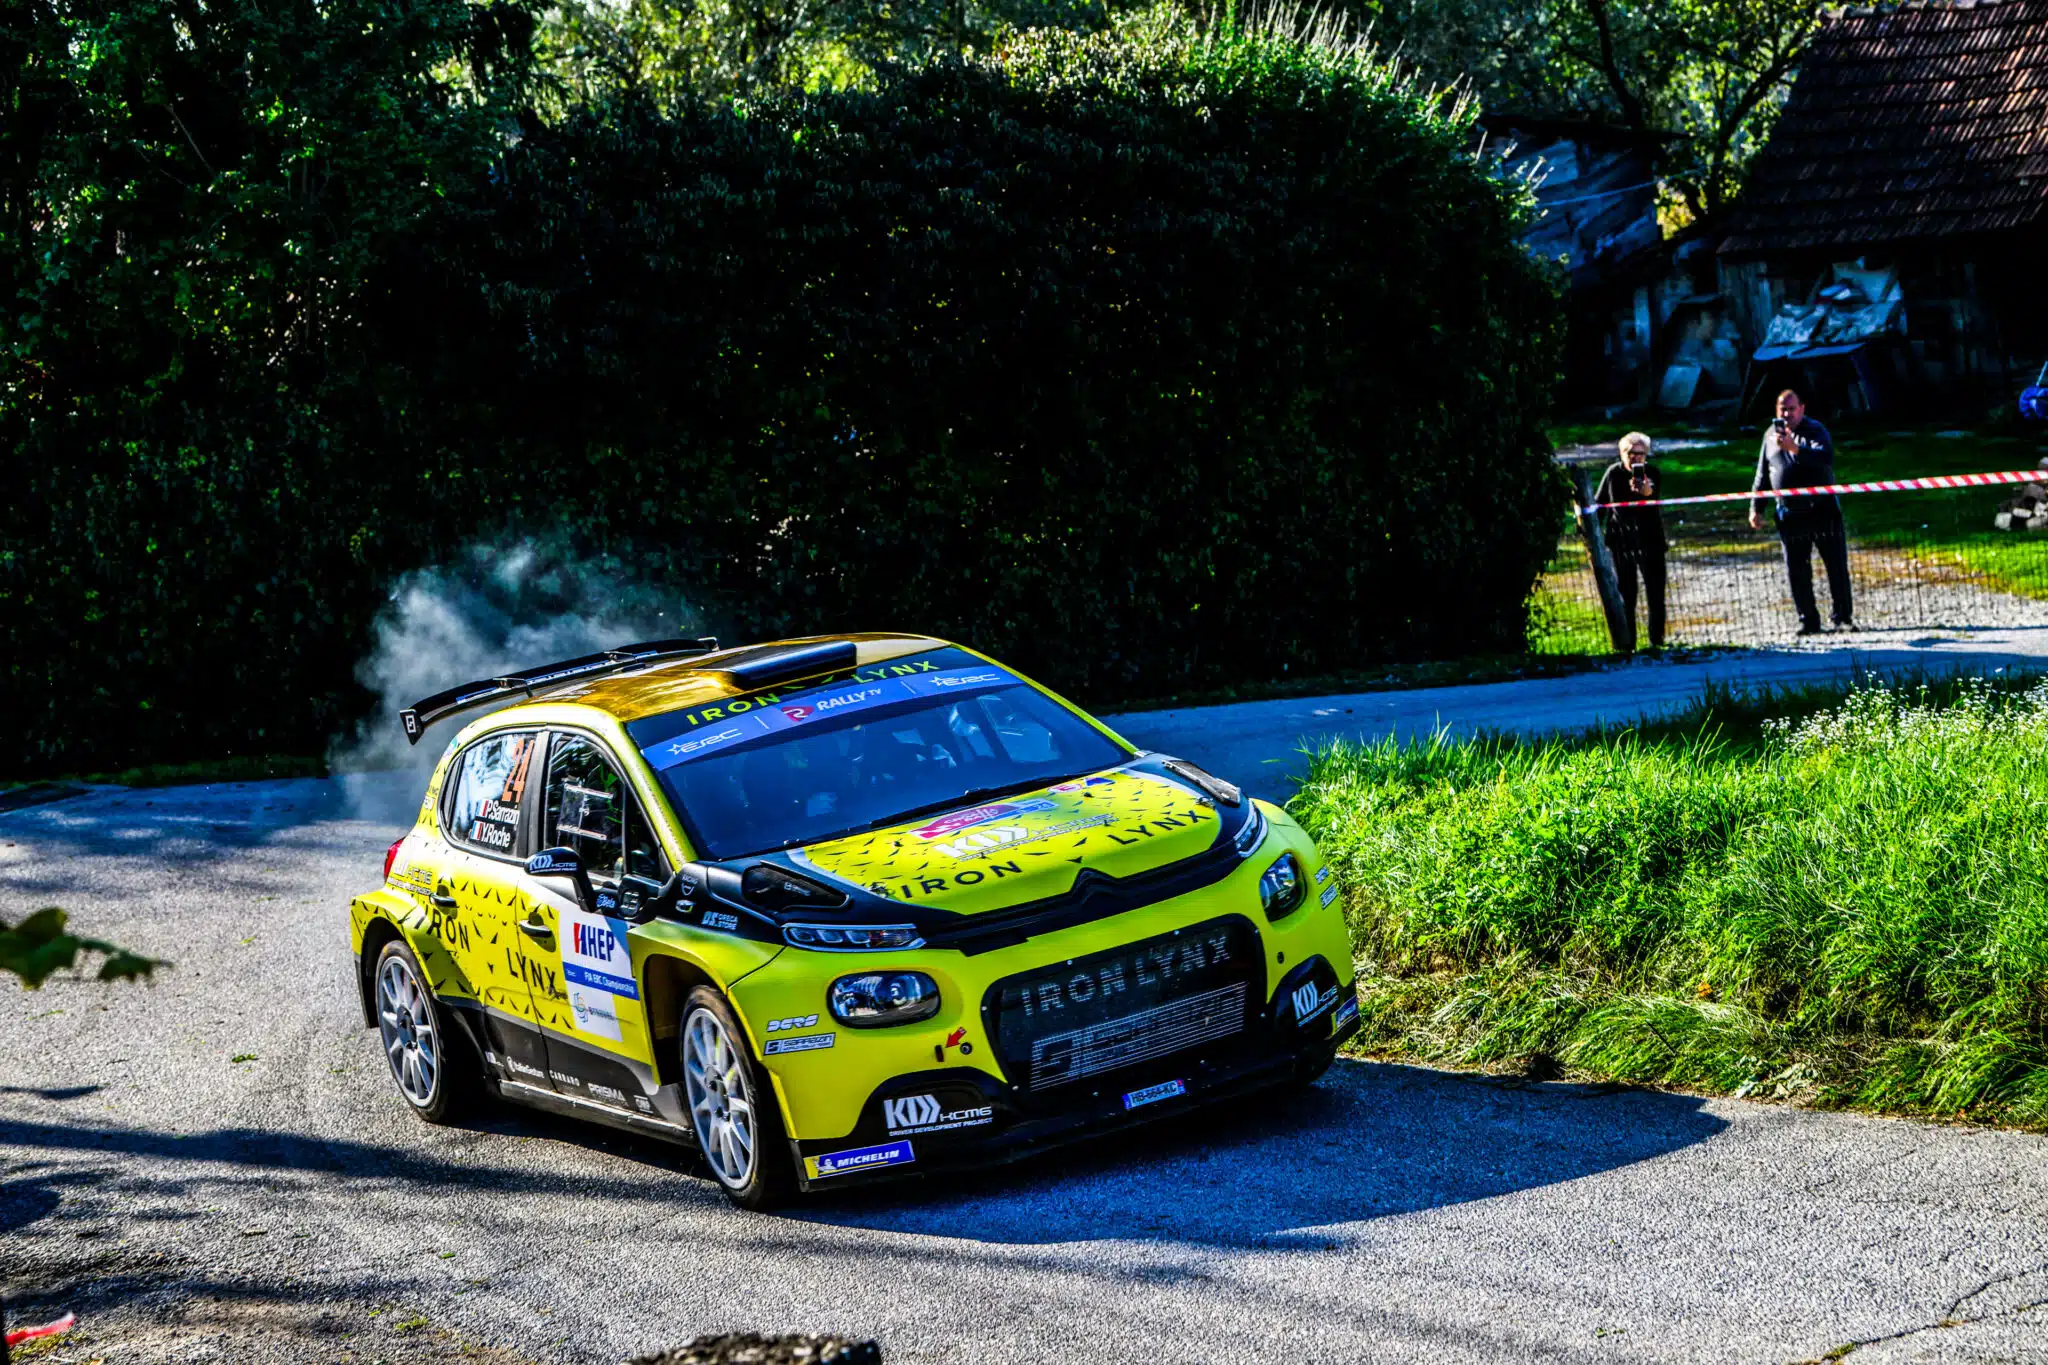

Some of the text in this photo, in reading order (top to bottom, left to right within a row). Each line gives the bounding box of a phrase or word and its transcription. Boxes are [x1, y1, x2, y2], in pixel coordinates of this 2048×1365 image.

[687, 661, 939, 725] IRON LYNX
[817, 691, 867, 711] RALLY
[868, 688, 881, 696] TV
[502, 739, 534, 803] 24
[481, 823, 511, 848] Y.Roche
[900, 860, 1022, 898] IRON
[1107, 810, 1211, 845] LYNX
[414, 904, 559, 998] IRON LYNX
[1021, 936, 1231, 1017] IRON LYNX
[915, 1122, 962, 1134] DEVELOPMENT
[962, 1117, 994, 1127] PROJECT
[837, 1150, 900, 1168] MICHELIN
